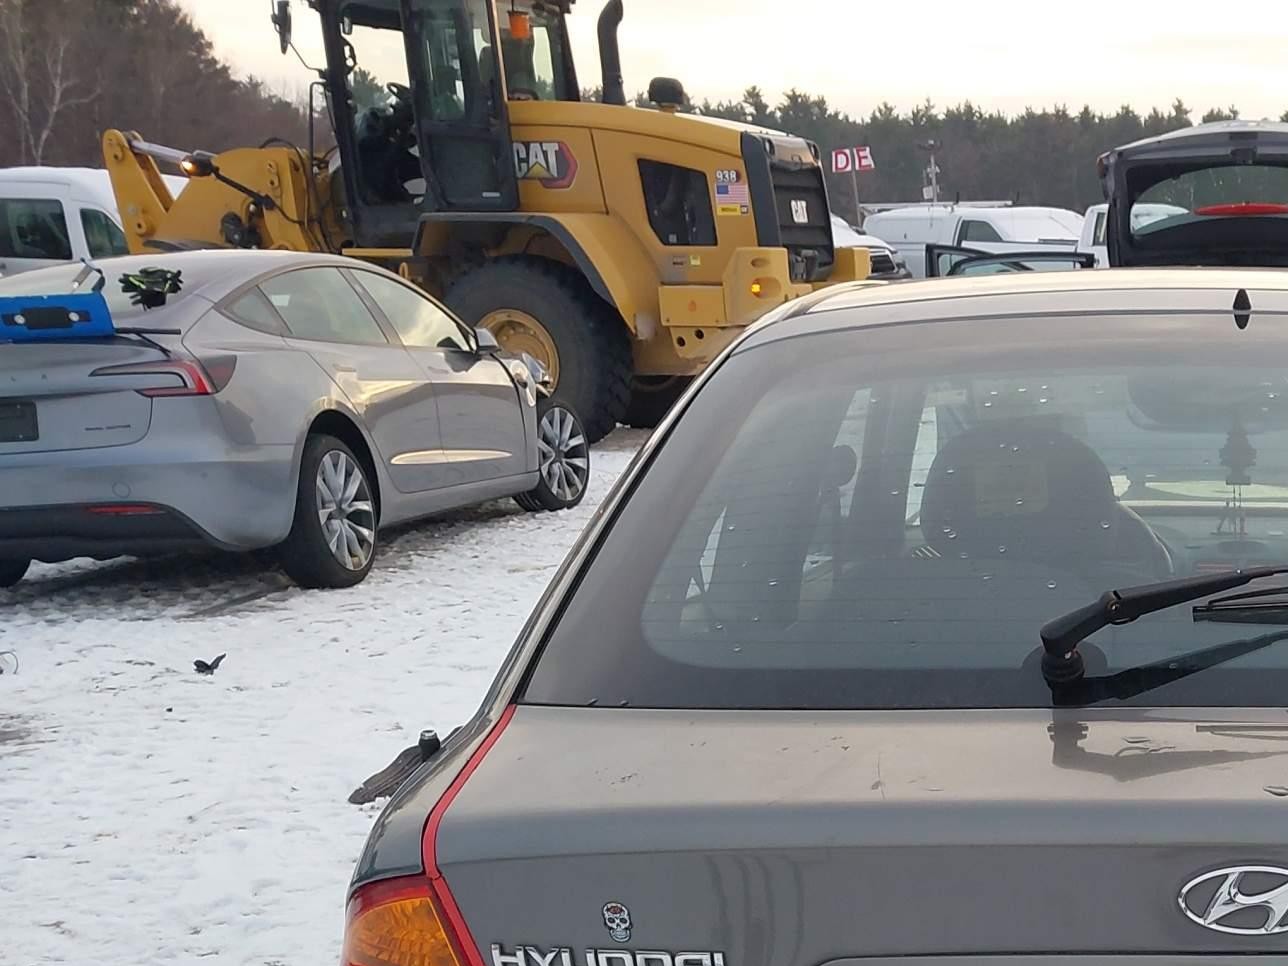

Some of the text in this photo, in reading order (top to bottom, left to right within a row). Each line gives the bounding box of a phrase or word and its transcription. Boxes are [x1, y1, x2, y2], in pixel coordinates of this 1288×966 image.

[512, 142, 559, 178] CAT
[716, 170, 737, 182] 938
[791, 199, 809, 224] CAT
